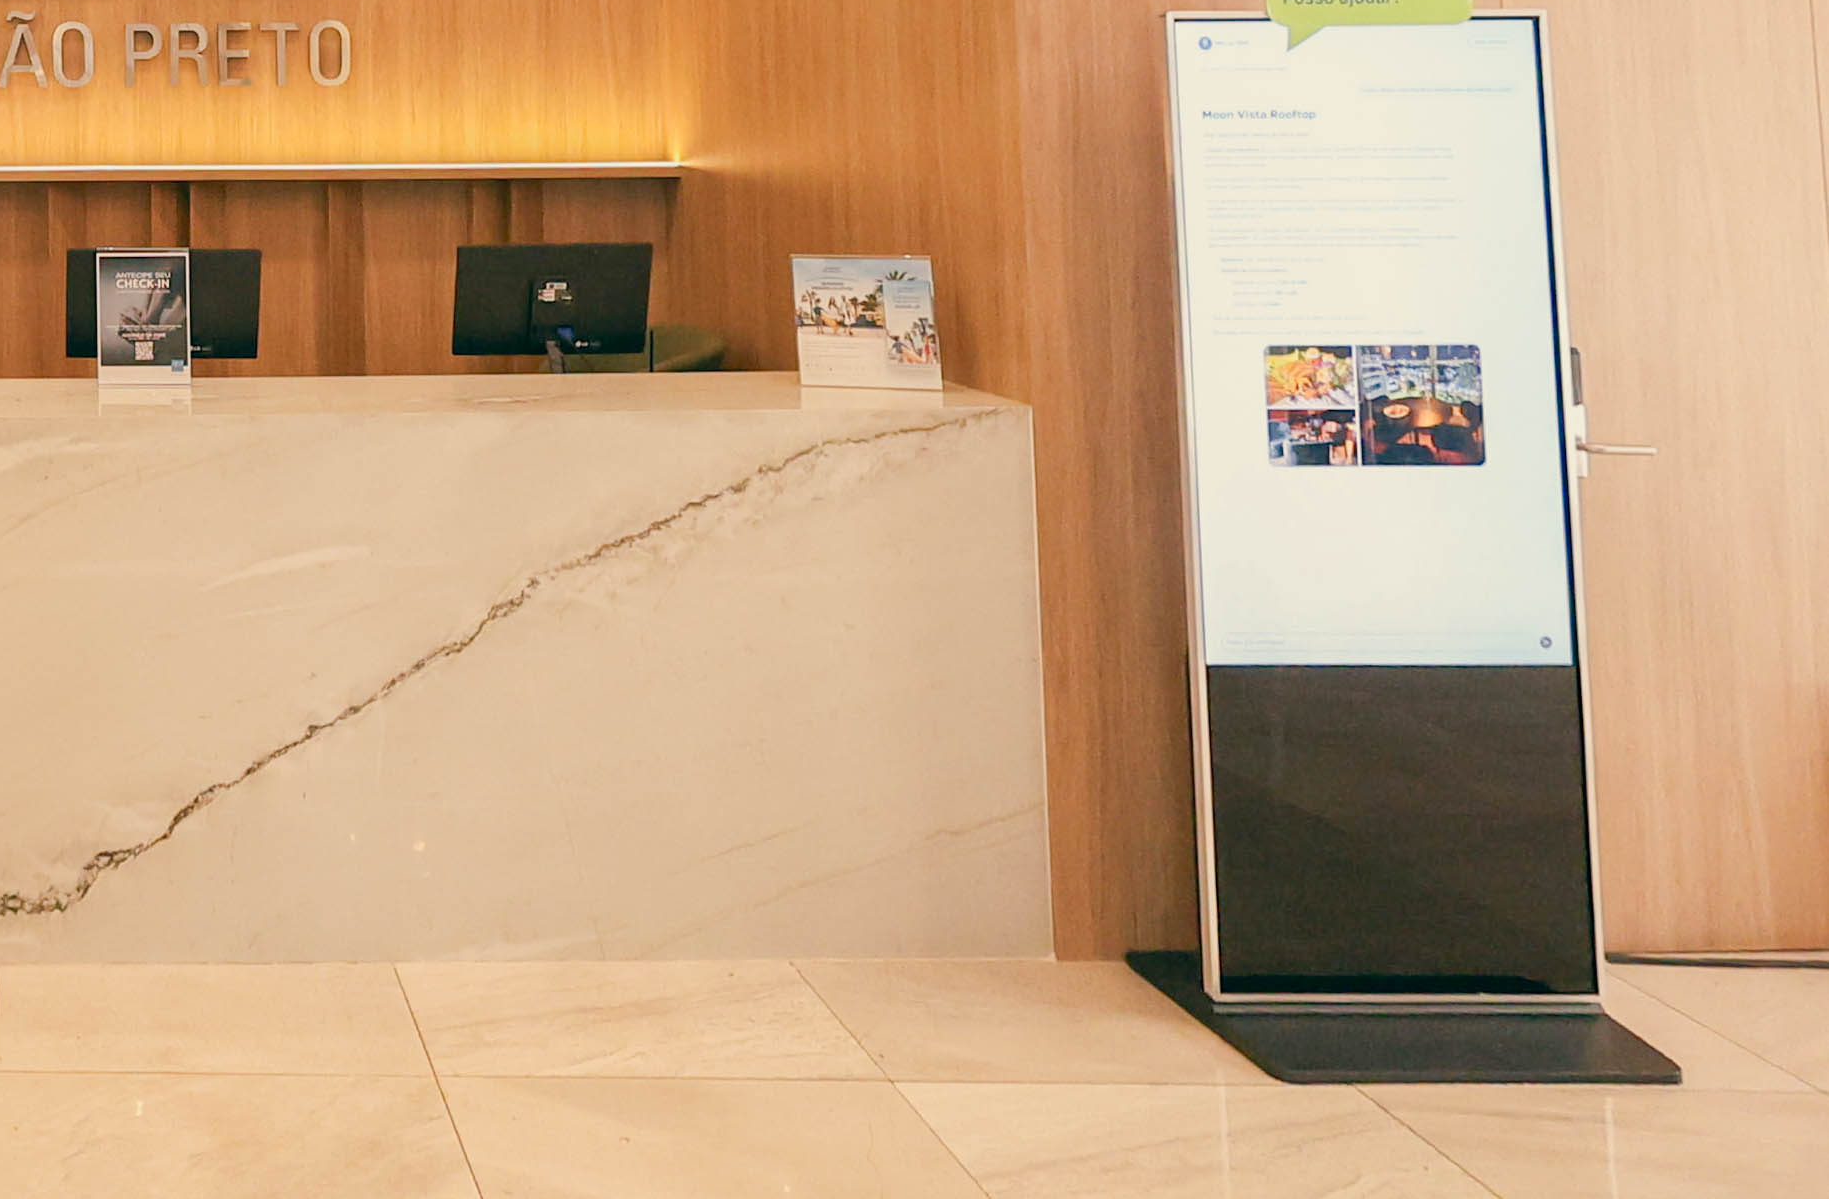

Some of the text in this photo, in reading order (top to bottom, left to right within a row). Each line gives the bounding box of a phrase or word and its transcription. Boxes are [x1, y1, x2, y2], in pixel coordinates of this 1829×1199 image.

[124, 19, 353, 89] PRETO
[1202, 110, 1234, 120] Moon
[1237, 110, 1267, 120] Vista
[115, 278, 170, 289] CHECK-IN
